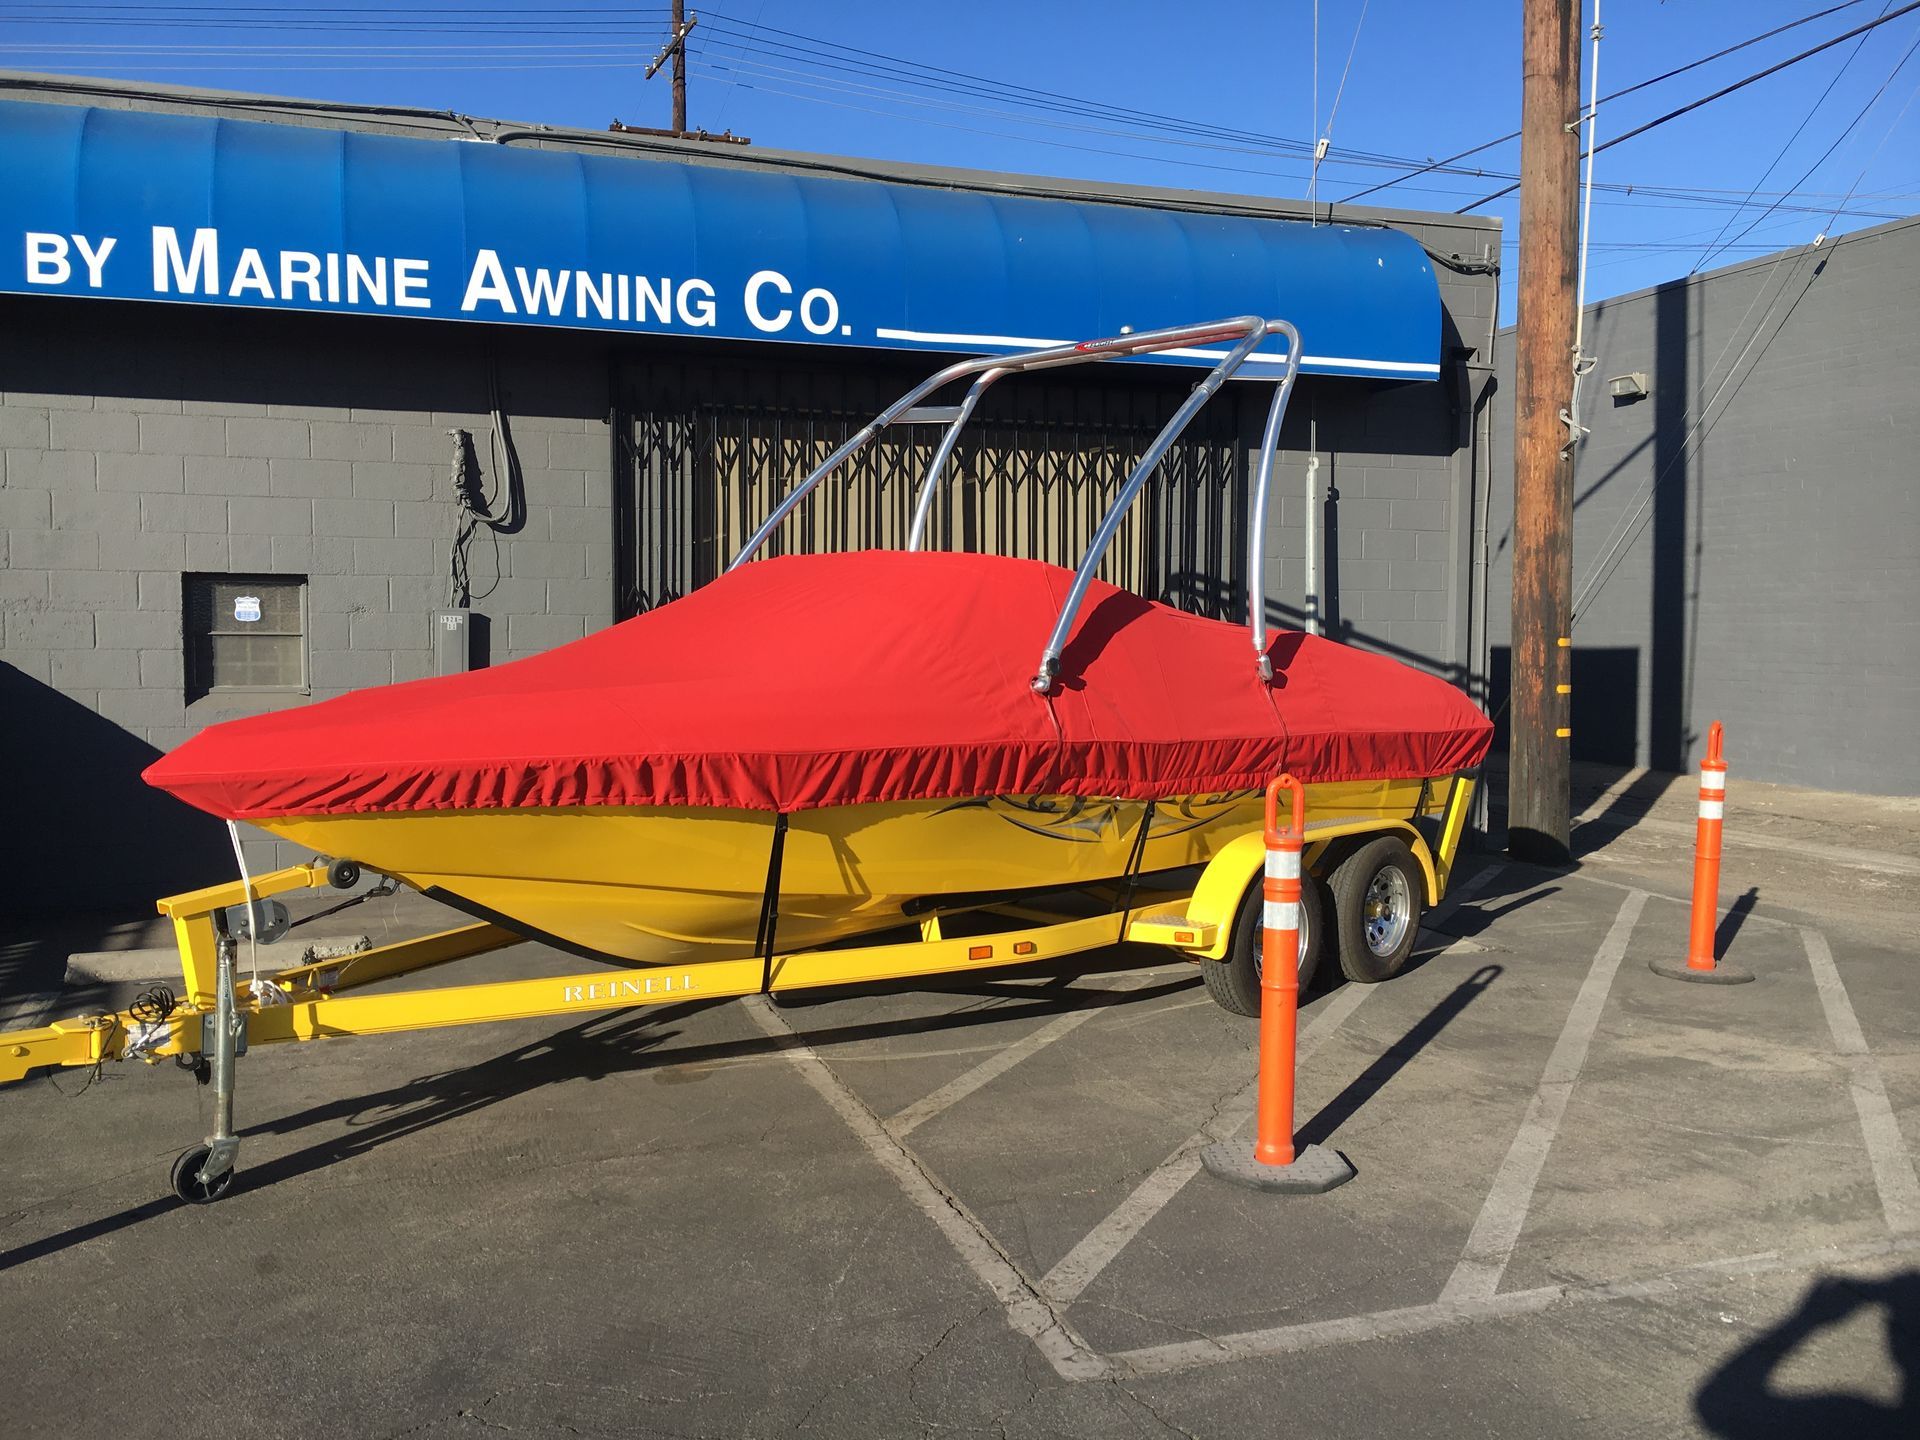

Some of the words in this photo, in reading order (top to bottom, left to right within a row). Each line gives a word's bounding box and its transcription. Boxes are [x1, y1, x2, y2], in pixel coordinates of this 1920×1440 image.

[25, 231, 117, 288] BY
[152, 225, 432, 309] MARINE
[460, 248, 717, 327] AWNING
[744, 270, 853, 336] CO.
[562, 974, 700, 1002] REINELL
